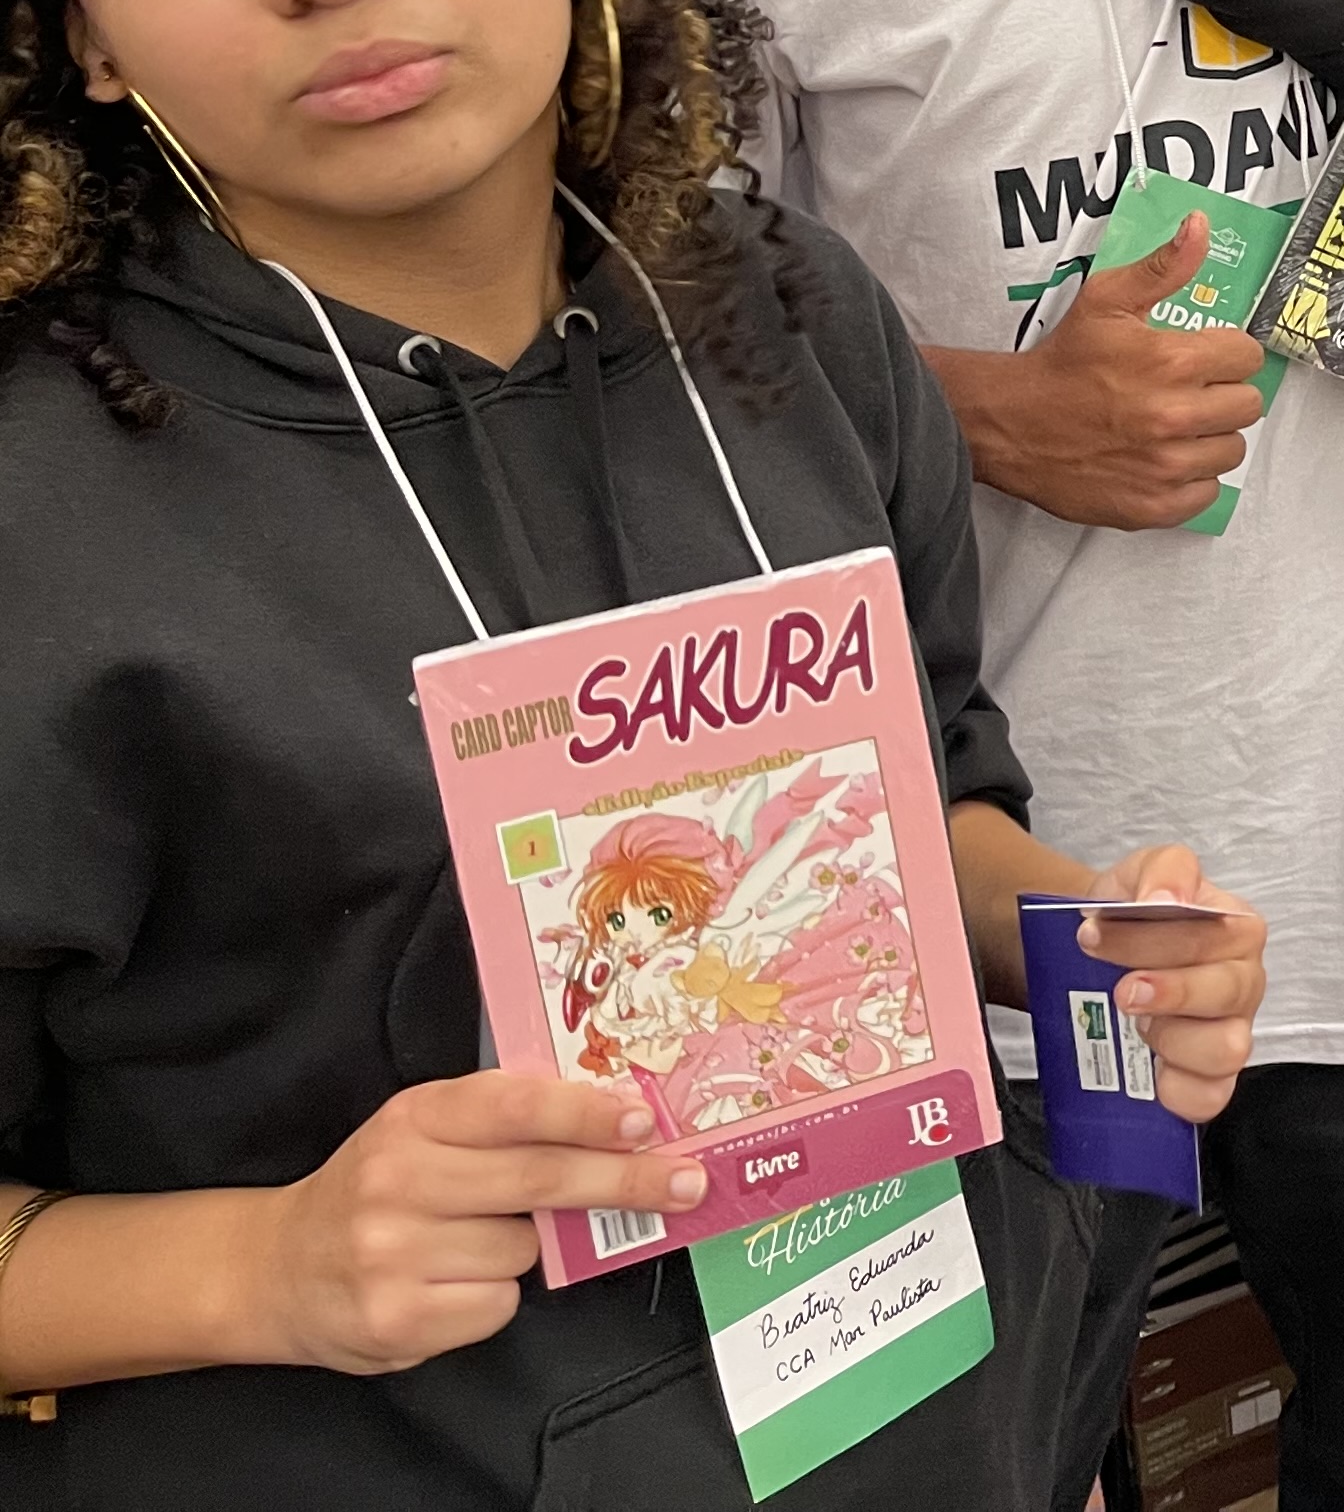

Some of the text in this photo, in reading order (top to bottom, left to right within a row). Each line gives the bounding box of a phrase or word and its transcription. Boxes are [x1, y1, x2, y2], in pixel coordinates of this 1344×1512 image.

[994, 81, 1318, 250] MUDAN
[1150, 301, 1238, 331] UDAN
[450, 694, 575, 762] CARD CAPTOR
[569, 598, 876, 767] SAKURA
[744, 1151, 800, 1185] Livre
[906, 1097, 953, 1147] JBC
[746, 1176, 908, 1276] História
[755, 1228, 936, 1350] Beatriz Eduarda
[775, 1275, 947, 1382] CCA Mar Paulista
